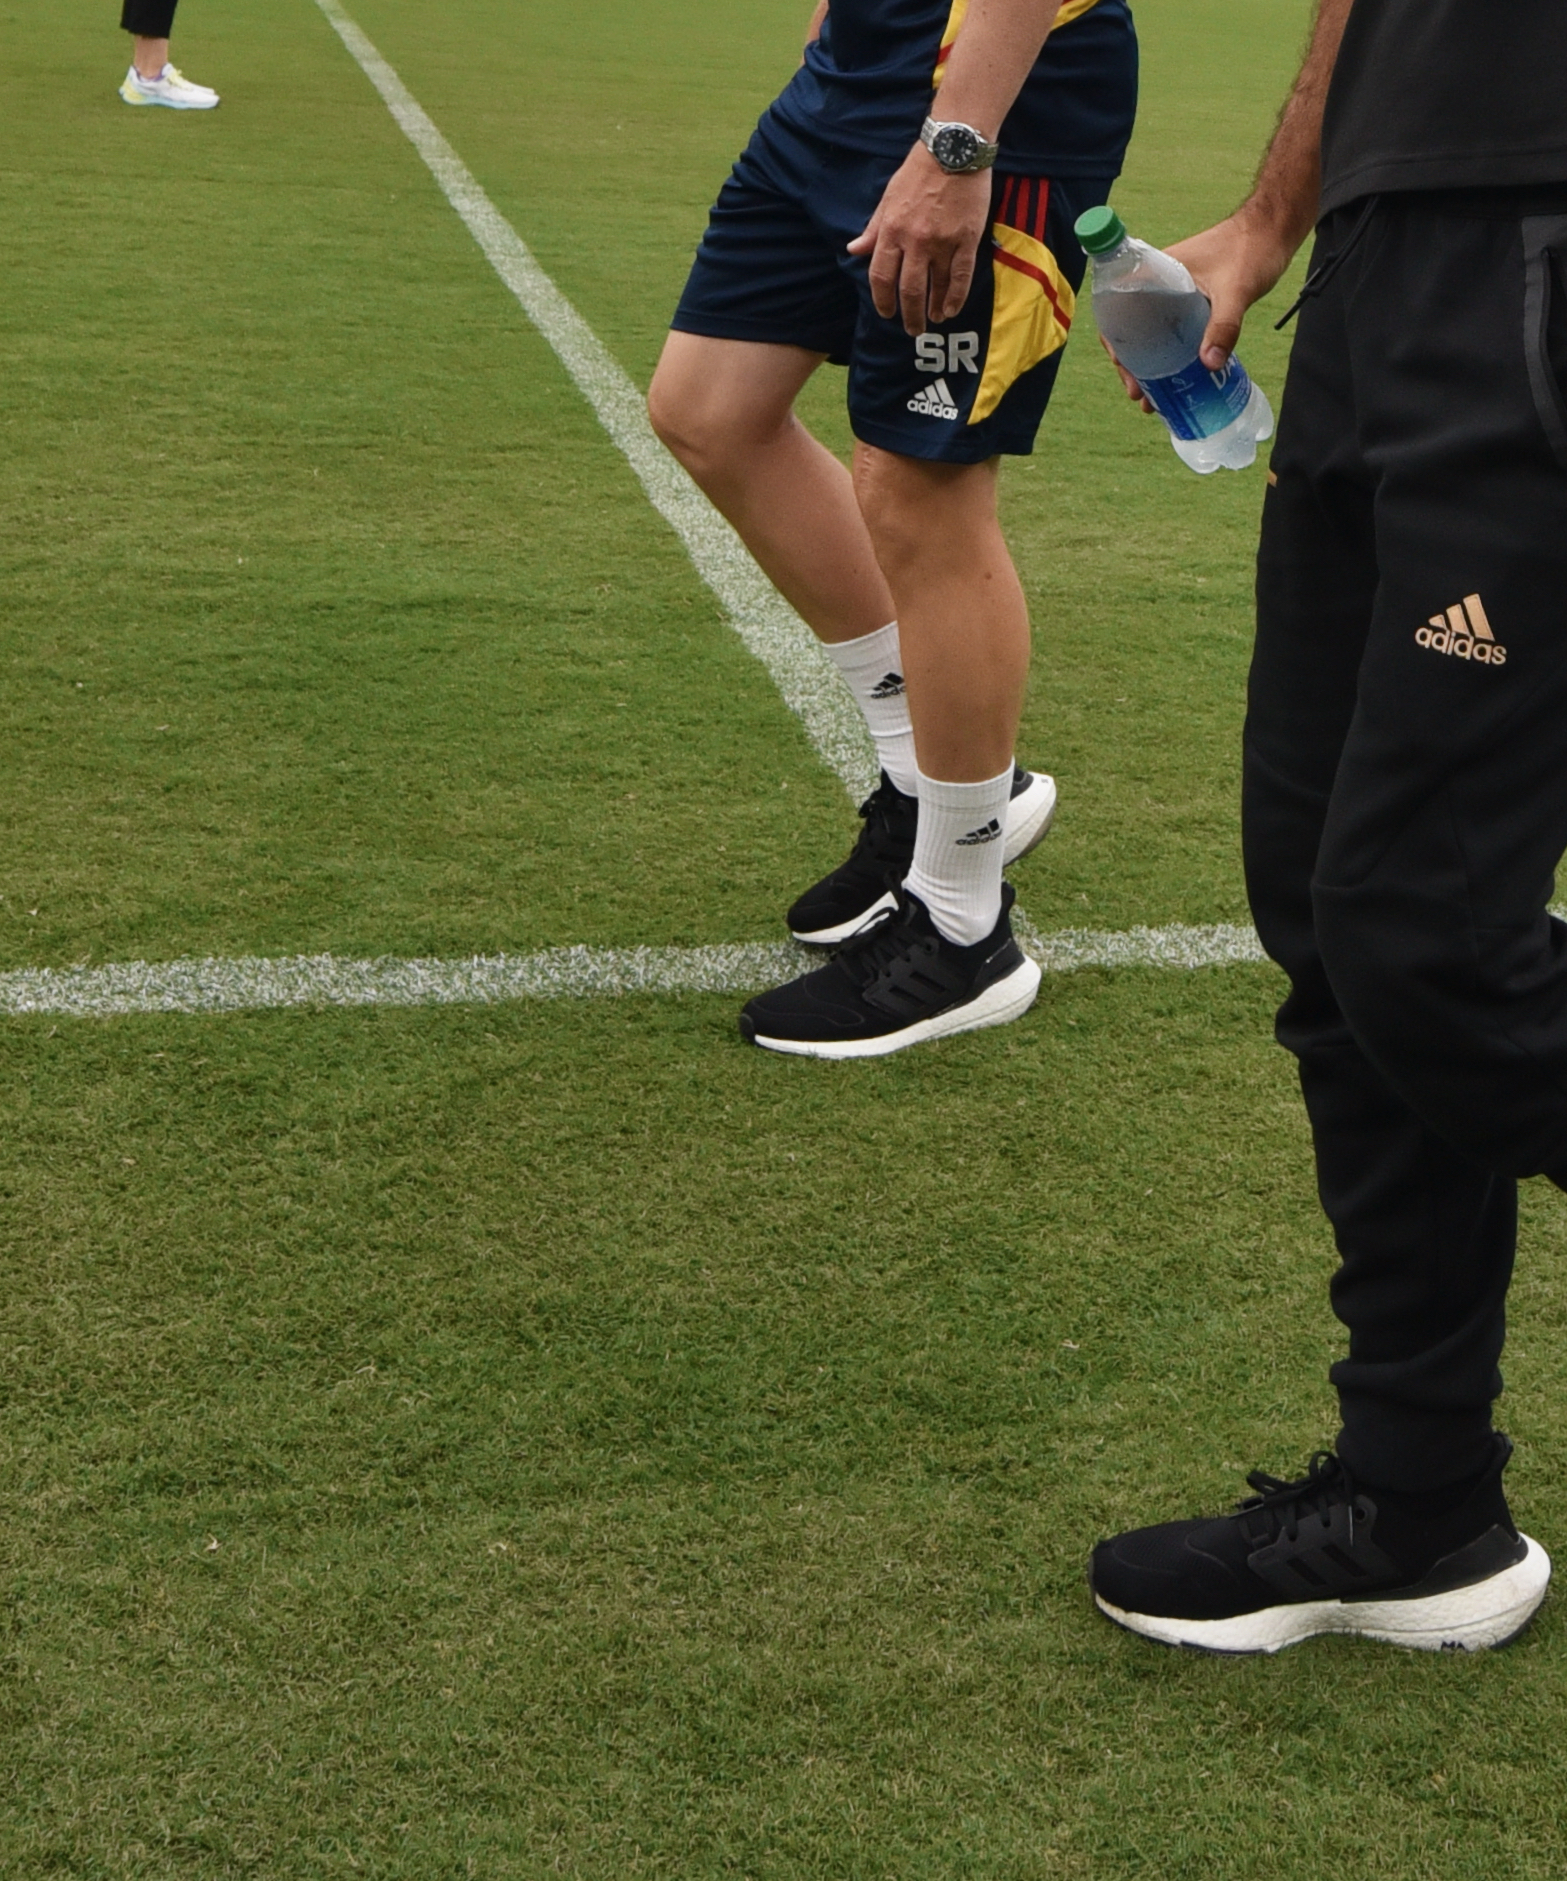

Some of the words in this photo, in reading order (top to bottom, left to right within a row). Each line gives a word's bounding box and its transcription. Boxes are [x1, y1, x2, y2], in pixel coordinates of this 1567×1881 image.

[914, 330, 980, 375] SR
[907, 383, 959, 421] adidas
[1415, 627, 1507, 665] adidas
[870, 683, 906, 700] adida
